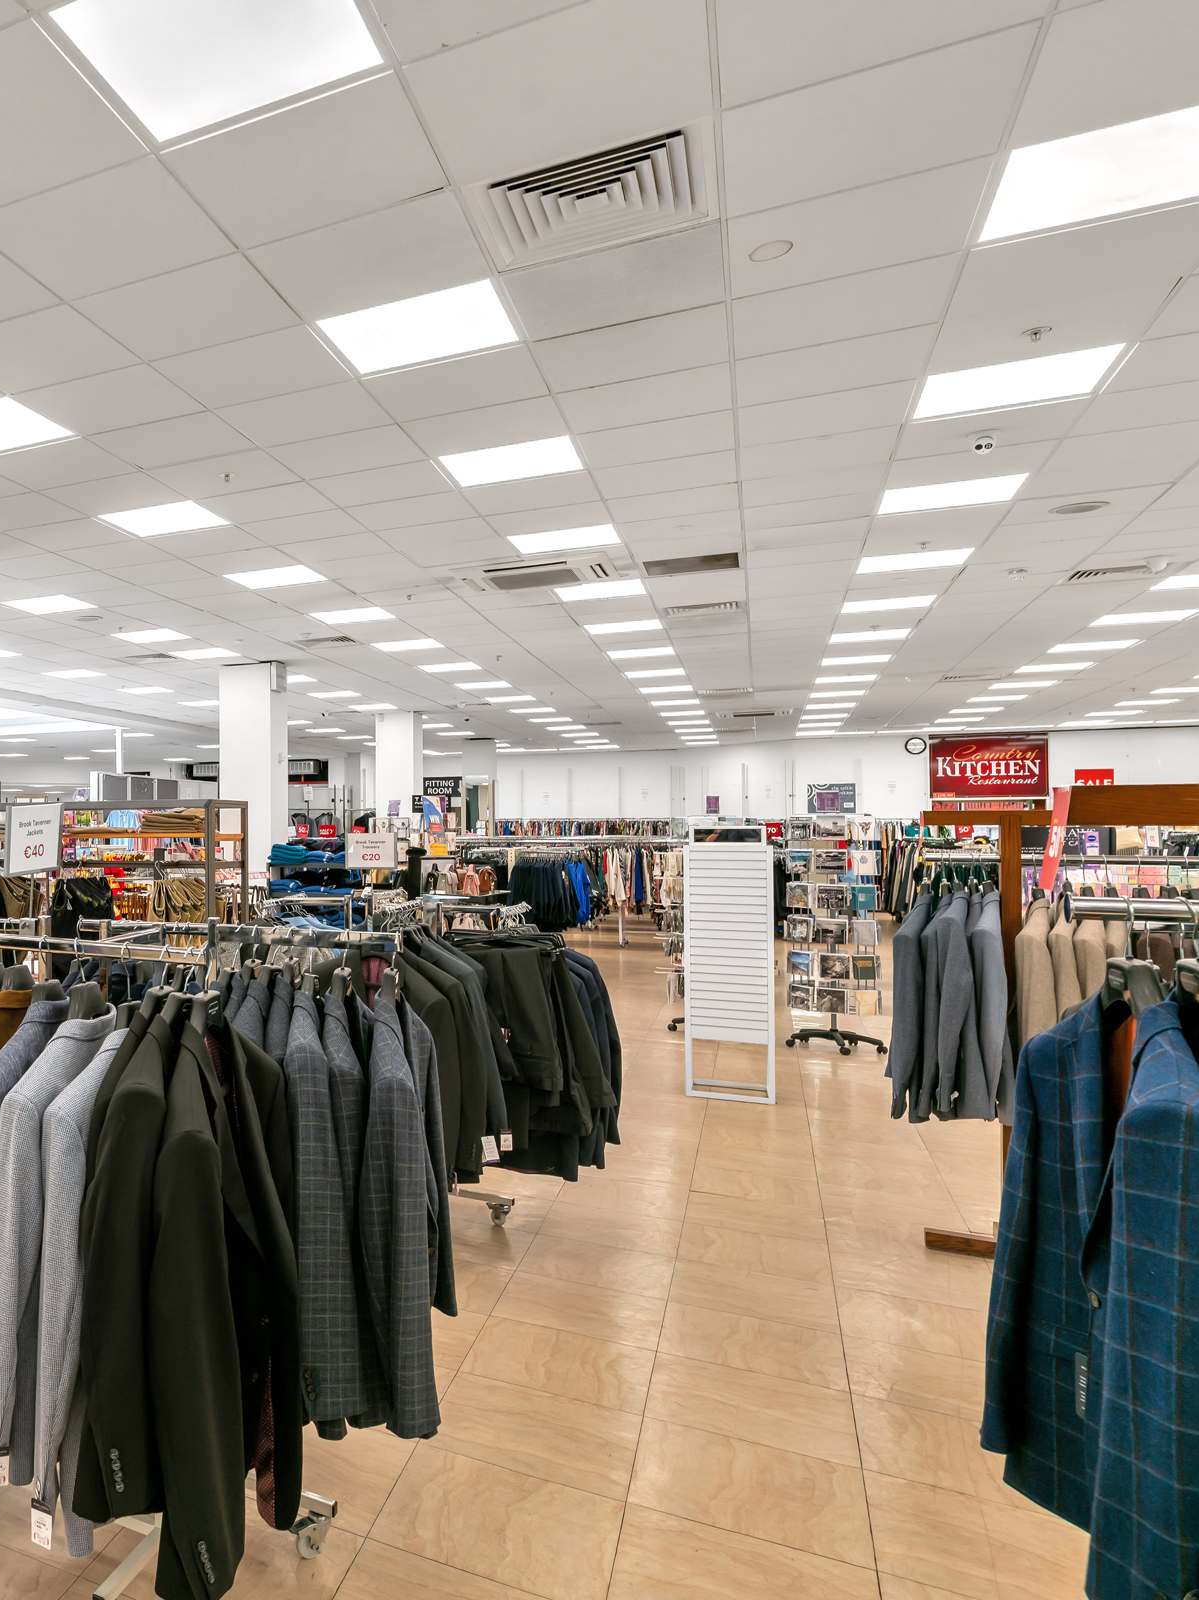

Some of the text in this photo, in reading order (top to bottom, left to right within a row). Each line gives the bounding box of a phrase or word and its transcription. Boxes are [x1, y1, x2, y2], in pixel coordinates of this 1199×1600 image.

[953, 745, 1038, 763] Country
[936, 757, 1041, 777] KITCHEN
[968, 775, 1038, 785] Restaurant
[24, 844, 44, 858] €40
[361, 853, 381, 861] €20
